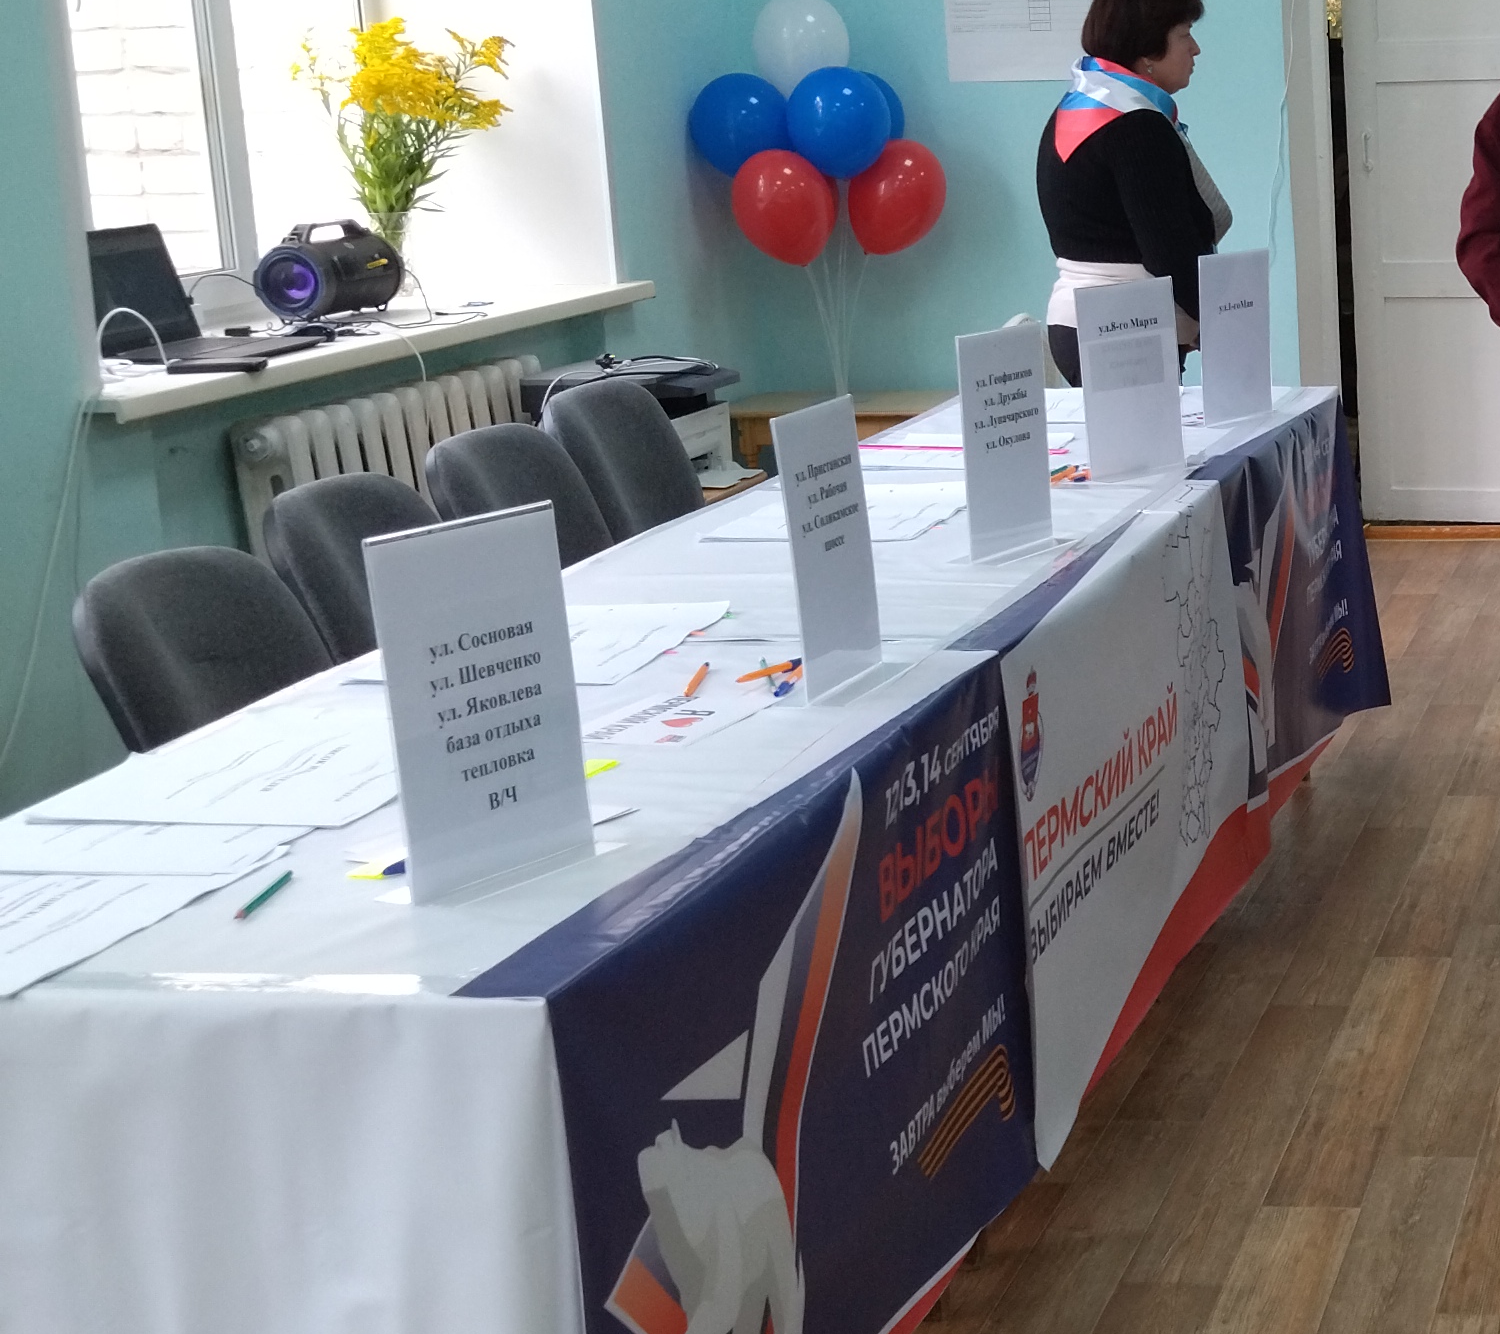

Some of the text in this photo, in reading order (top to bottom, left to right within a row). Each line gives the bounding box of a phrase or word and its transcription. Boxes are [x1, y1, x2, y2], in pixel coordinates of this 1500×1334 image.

[1130, 317, 1158, 329] Марта
[997, 388, 1027, 406] Дружбы
[998, 431, 1030, 448] Окулова
[429, 620, 534, 664] ул. Сосновая
[430, 651, 541, 698] ул. Шевченко
[437, 682, 542, 729] ул. Яковлева
[446, 713, 542, 754] база отдыха
[944, 705, 1000, 776] СЕНТЯБРЯ
[461, 747, 535, 782] тепловка
[1024, 682, 1178, 882] ПЕРМСКИЙ КРАЙ
[488, 785, 518, 810] В/Ч
[1106, 789, 1160, 872] ВМЕСТЕ!
[869, 837, 998, 1004] ГУБЕРНАТОРА
[862, 895, 1000, 1079] ПЕРМСКОГО КРАЯ
[890, 1093, 936, 1175] ЗАВТРА
[982, 993, 1006, 1045] МЫ!
